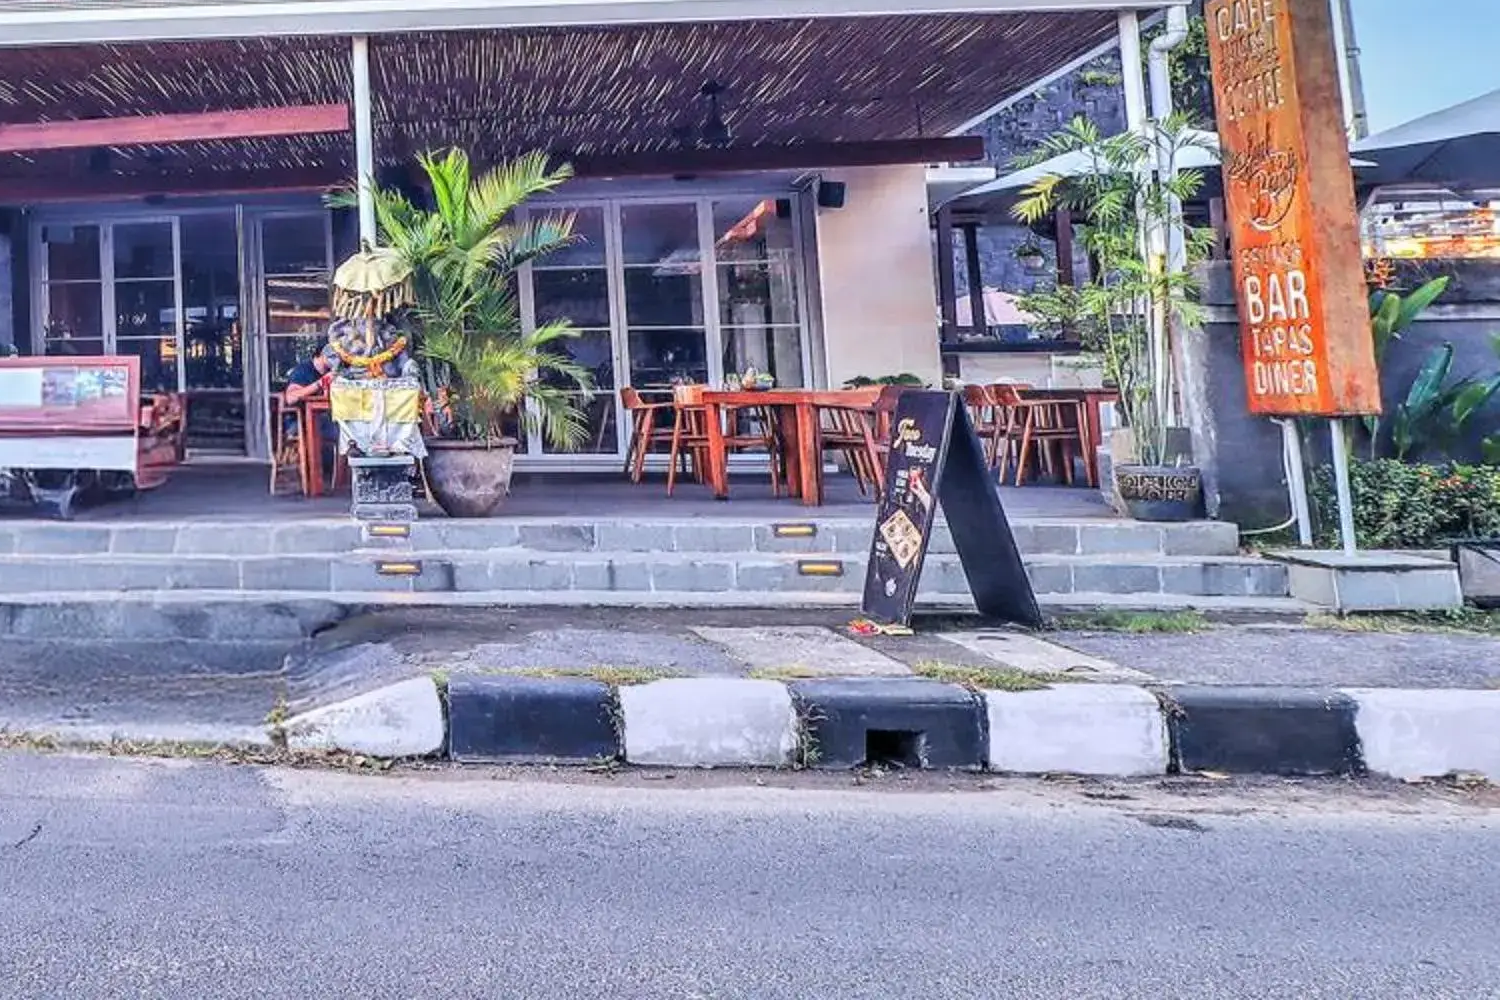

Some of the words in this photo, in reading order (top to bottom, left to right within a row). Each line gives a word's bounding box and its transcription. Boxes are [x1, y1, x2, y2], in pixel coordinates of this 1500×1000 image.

[1223, 66, 1285, 121] COFFEE
[1245, 269, 1310, 324] BAR
[1251, 322, 1314, 358] TAPAS
[1254, 358, 1318, 395] DINER
